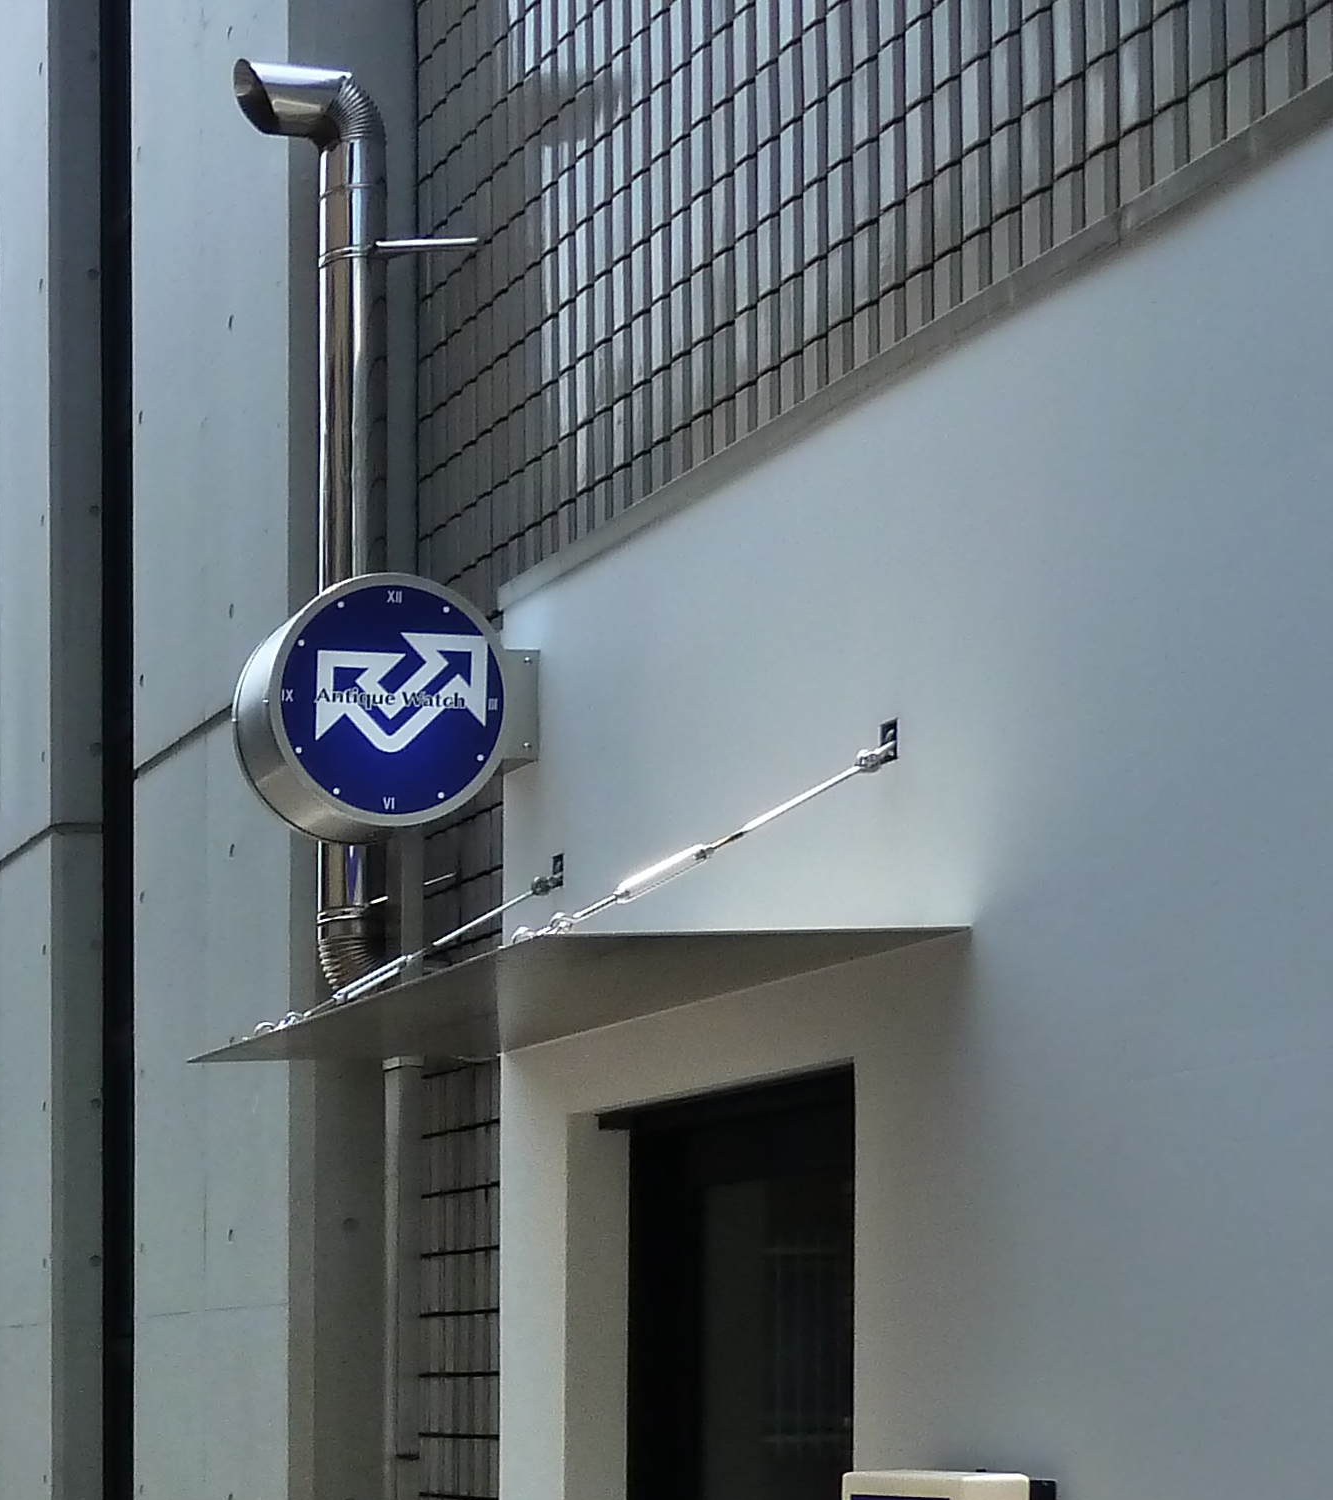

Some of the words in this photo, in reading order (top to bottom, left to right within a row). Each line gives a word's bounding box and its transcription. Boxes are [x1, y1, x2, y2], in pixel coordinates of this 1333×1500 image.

[387, 591, 403, 603] XII
[314, 687, 396, 711] Antique
[402, 690, 466, 710] Watch
[383, 797, 395, 810] VI
